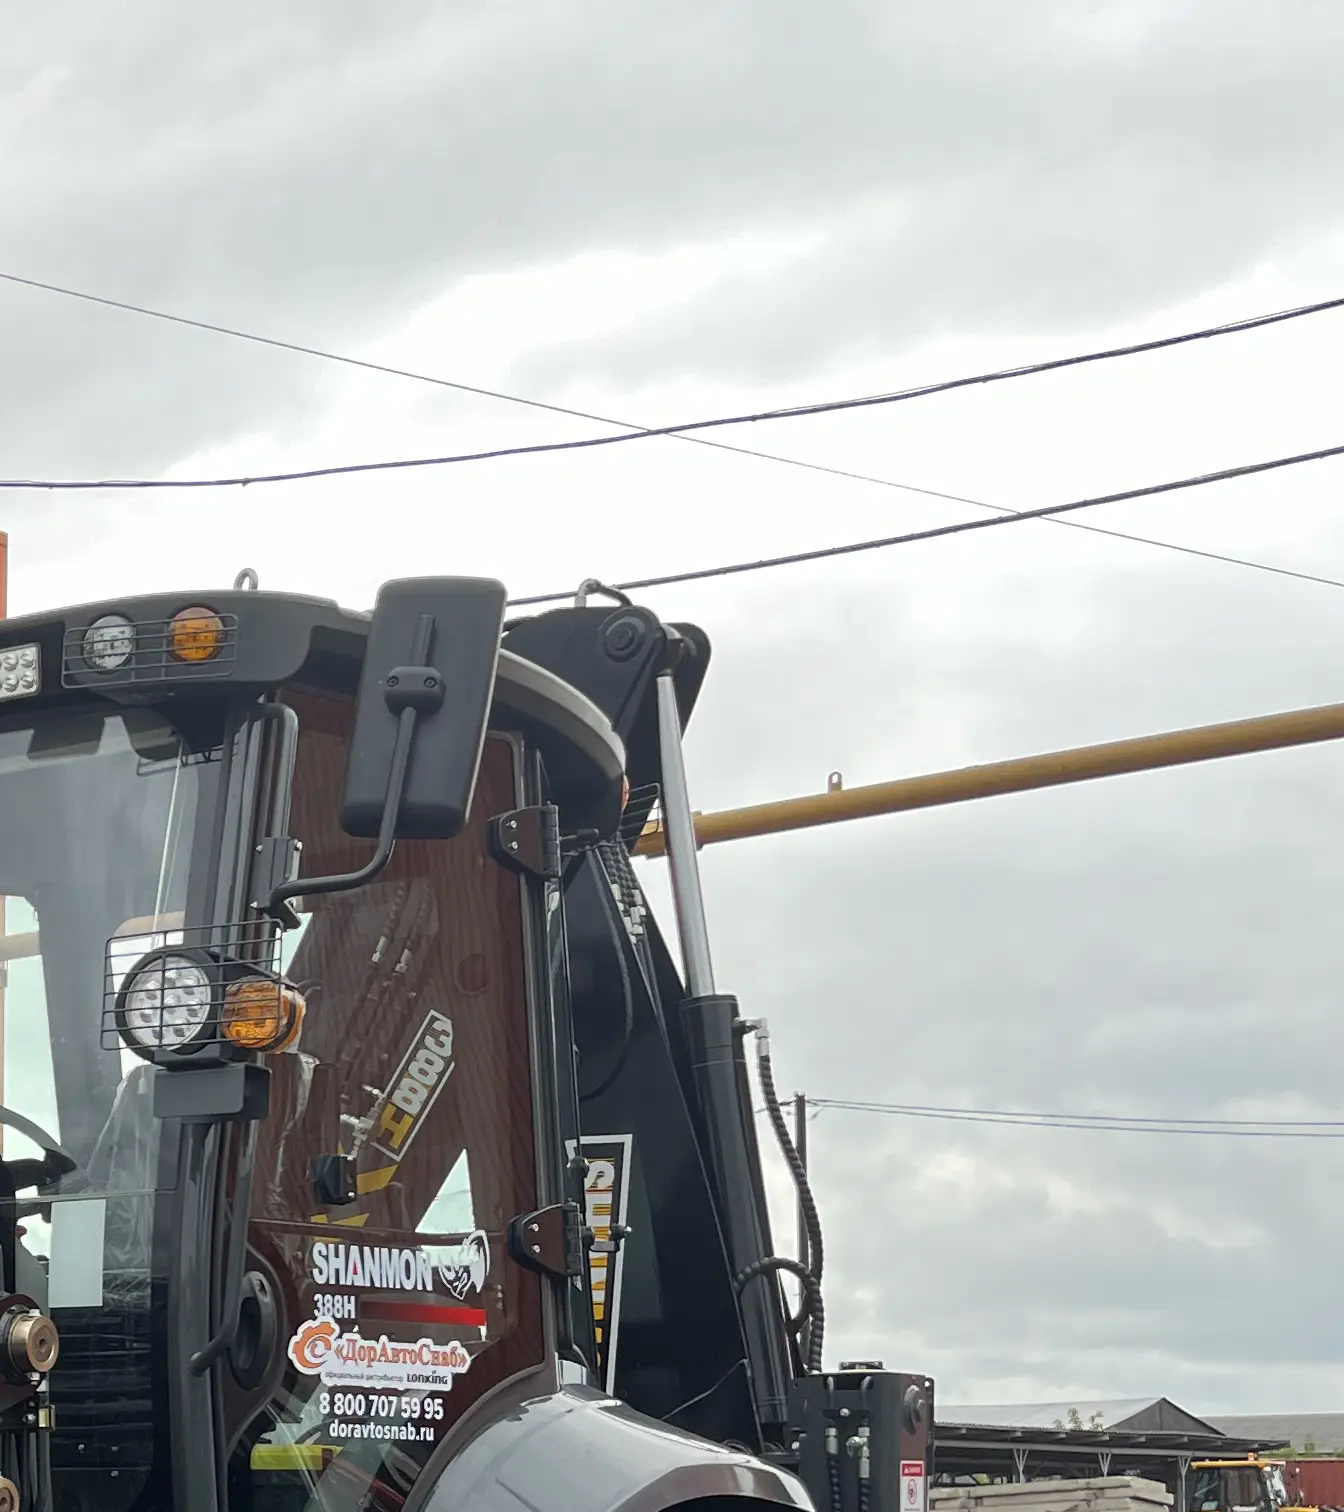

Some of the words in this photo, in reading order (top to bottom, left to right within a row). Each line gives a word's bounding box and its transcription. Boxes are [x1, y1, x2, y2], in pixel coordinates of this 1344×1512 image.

[377, 1020, 453, 1149] 388H
[312, 1242, 433, 1291] SHANMON
[314, 1294, 355, 1319] 388H
[334, 1338, 467, 1368] «ДорАвтоСнаб»
[319, 1392, 331, 1414] 8
[333, 1393, 365, 1415] 800
[369, 1395, 397, 1417] 707
[401, 1397, 421, 1419] 59
[424, 1398, 444, 1420] 95
[329, 1419, 435, 1441] doravtosnab.ru
